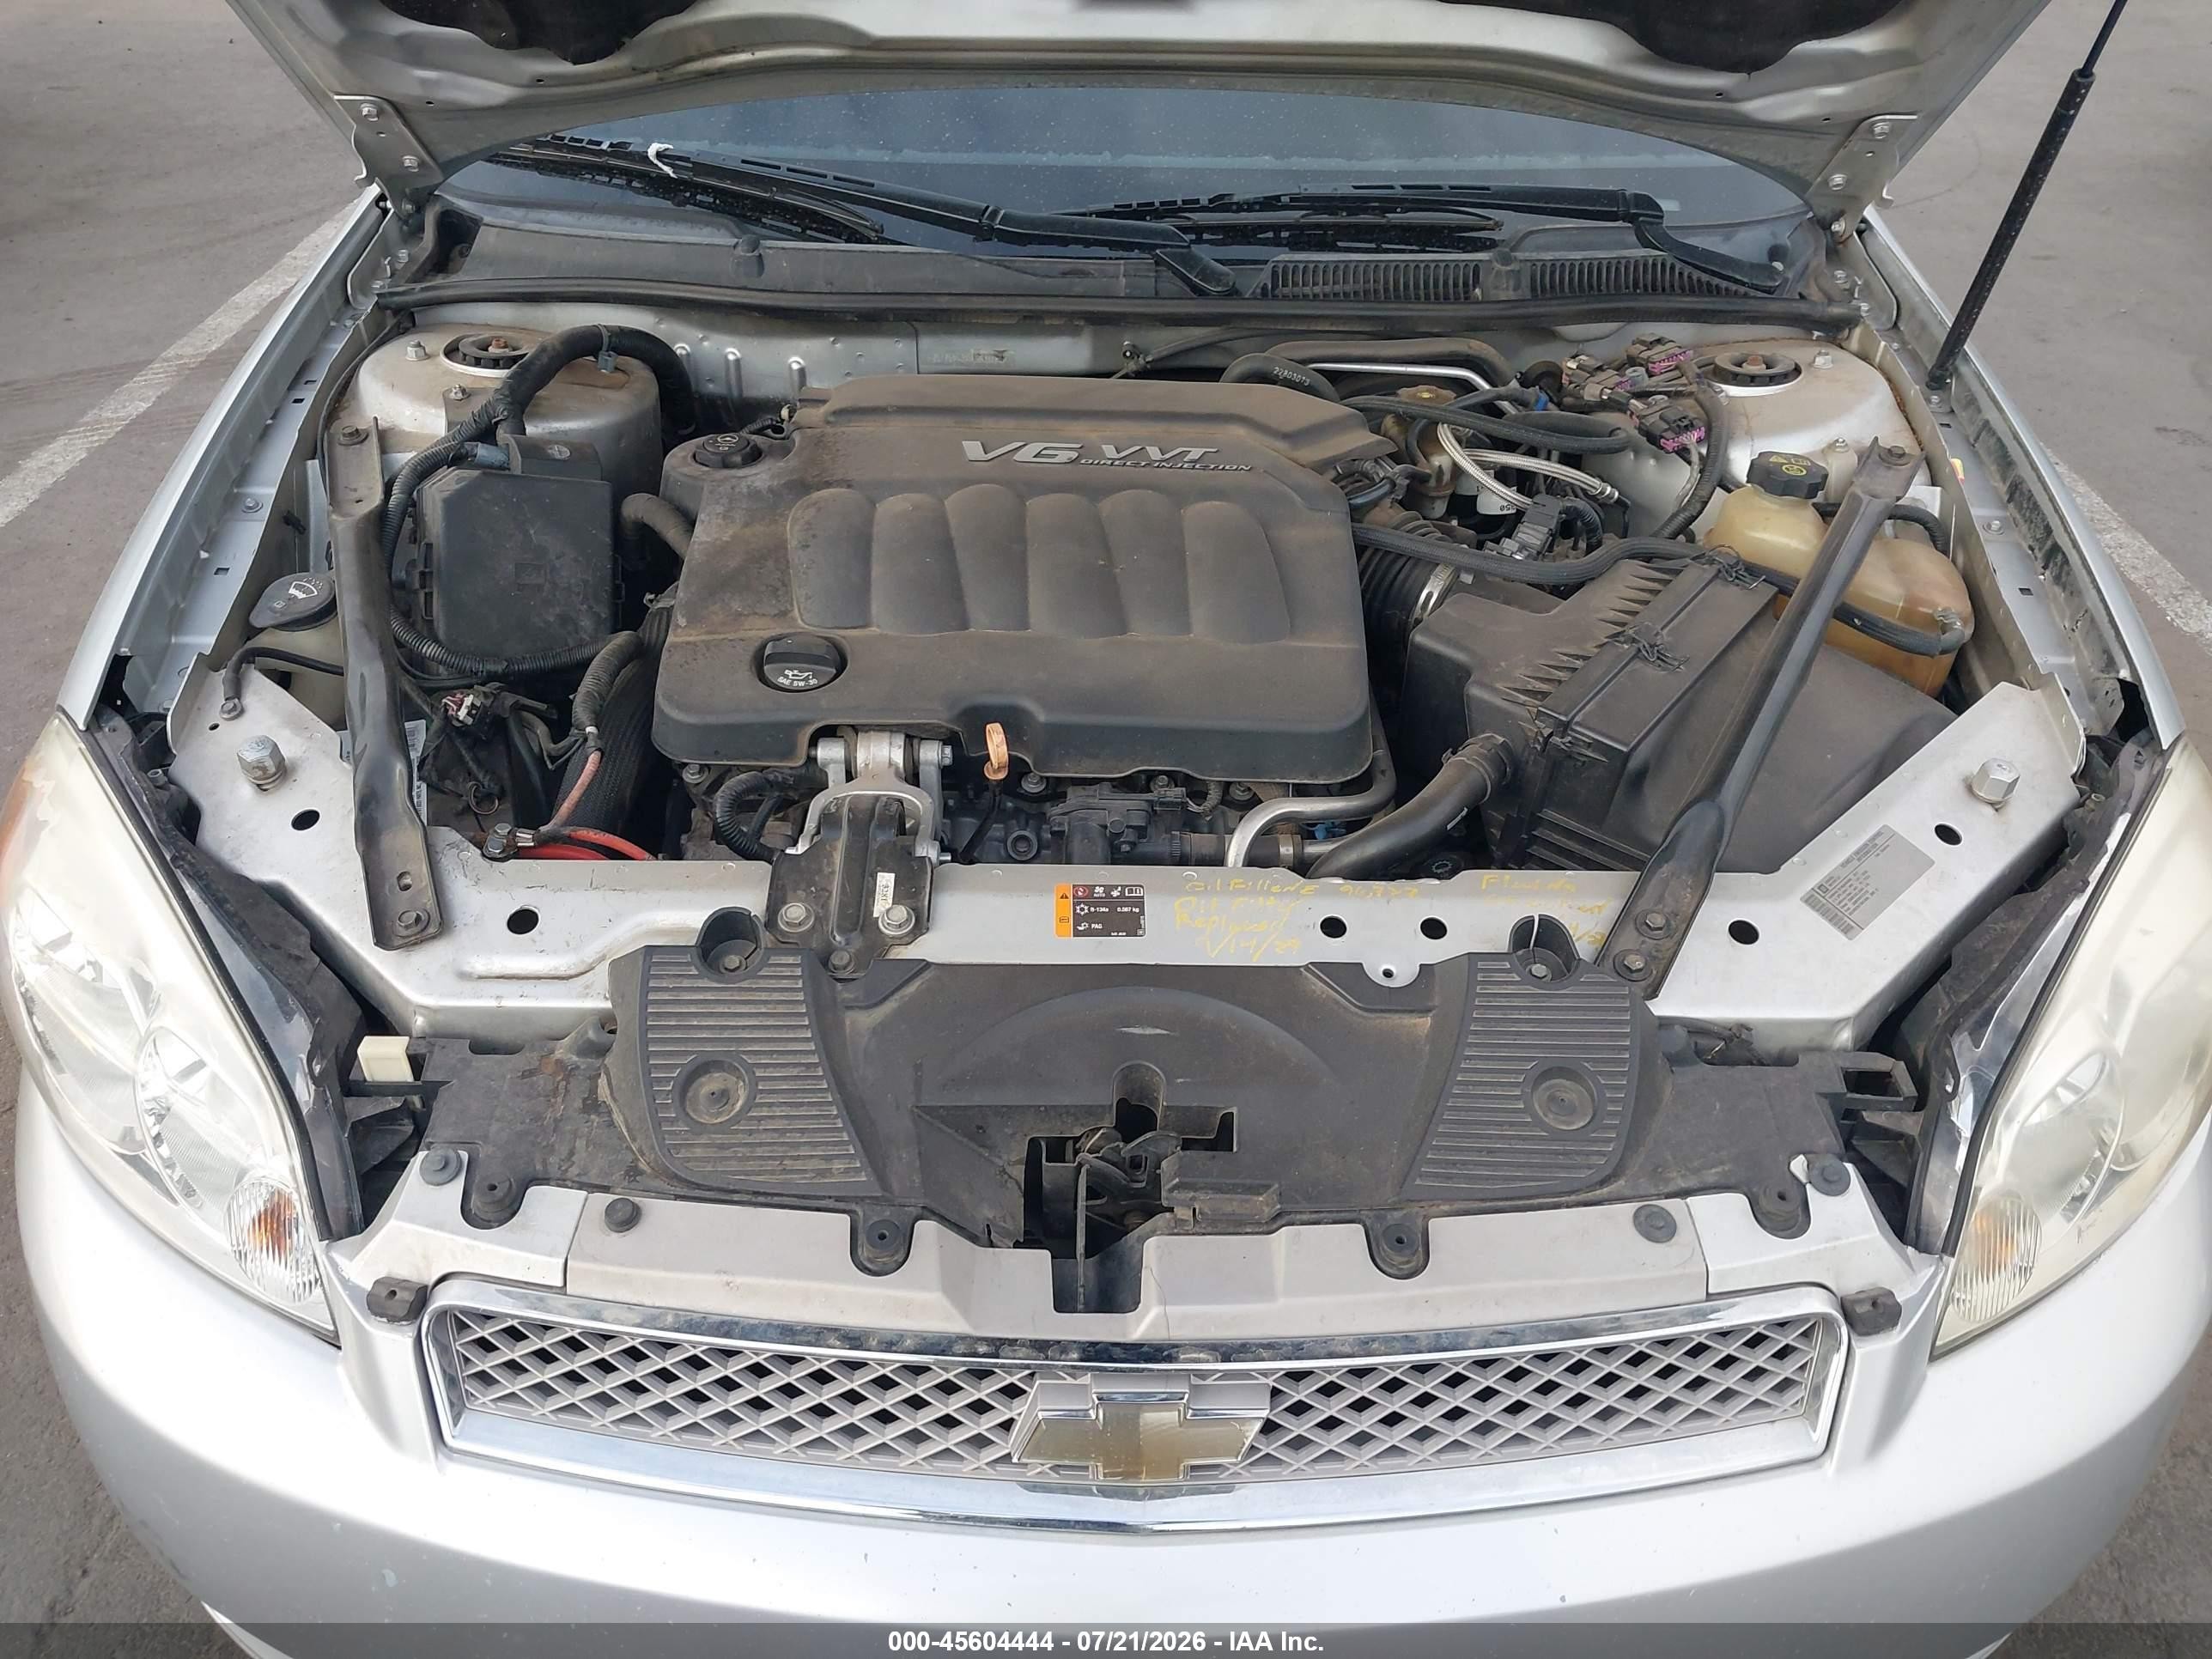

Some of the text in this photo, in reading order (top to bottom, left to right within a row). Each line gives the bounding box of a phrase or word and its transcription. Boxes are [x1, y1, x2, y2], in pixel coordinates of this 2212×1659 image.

[961, 440, 1218, 465] V6 VVT
[1079, 458, 1251, 471] DIRECT INJECTION
[777, 676, 792, 685] SAE
